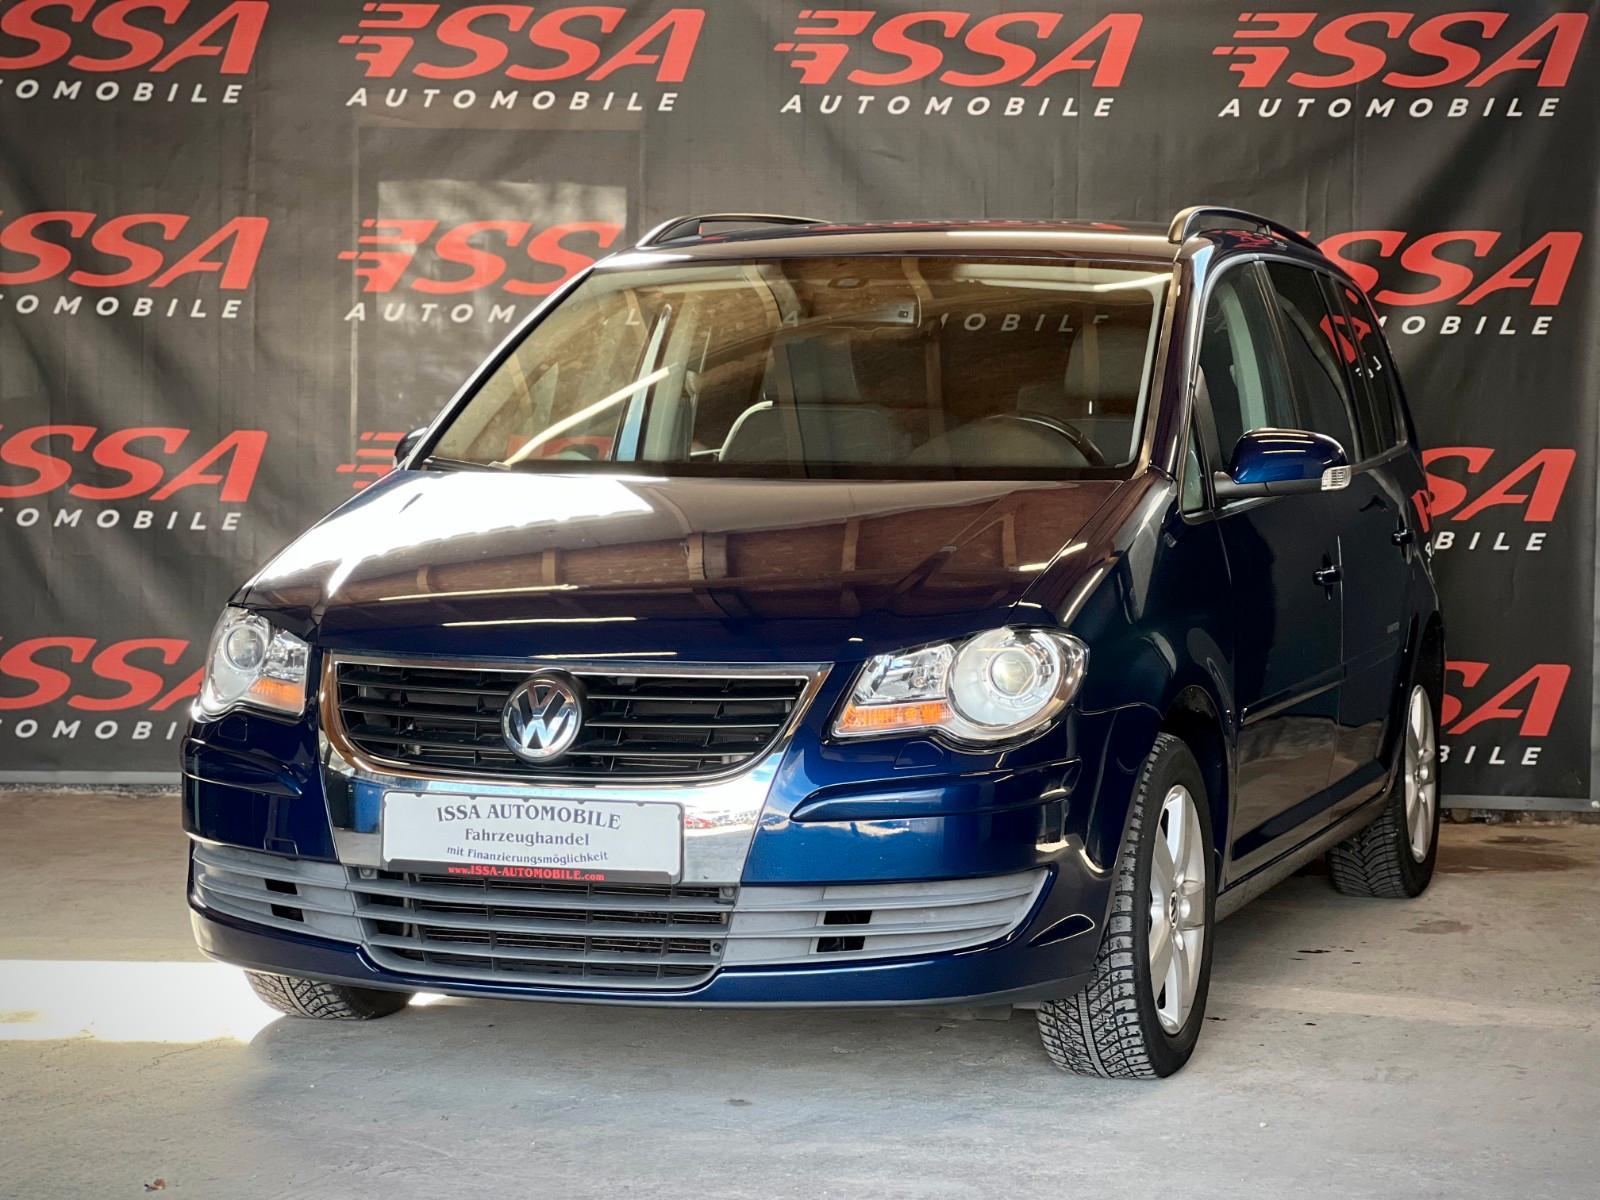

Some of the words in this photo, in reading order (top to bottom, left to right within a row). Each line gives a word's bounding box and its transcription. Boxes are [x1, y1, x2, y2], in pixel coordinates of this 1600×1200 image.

[0, 0, 269, 73] SSA
[0, 79, 242, 104] OMOBILE
[345, 87, 678, 112] AUTOMOBILE
[780, 94, 1114, 117] AUTOMOBILE
[1217, 97, 1560, 118] AUTOMOBILE
[0, 211, 269, 289] SSA
[1310, 230, 1582, 306] SSA
[0, 294, 242, 319] OMOBILE
[1379, 315, 1553, 335] OBILE
[0, 425, 268, 502] SSA
[1421, 447, 1576, 521] SA
[0, 507, 242, 531] OMOBILE
[1434, 531, 1547, 551] BILE
[437, 804, 481, 822] ISSA
[487, 803, 621, 830] AUTOMOBILE
[465, 828, 590, 846] Fahrzeughandel
[447, 846, 464, 857] mit
[467, 848, 609, 866] Finanzierungsmöglichkeit
[447, 864, 605, 882] www.ISSA-AUTOMOBILE.com
